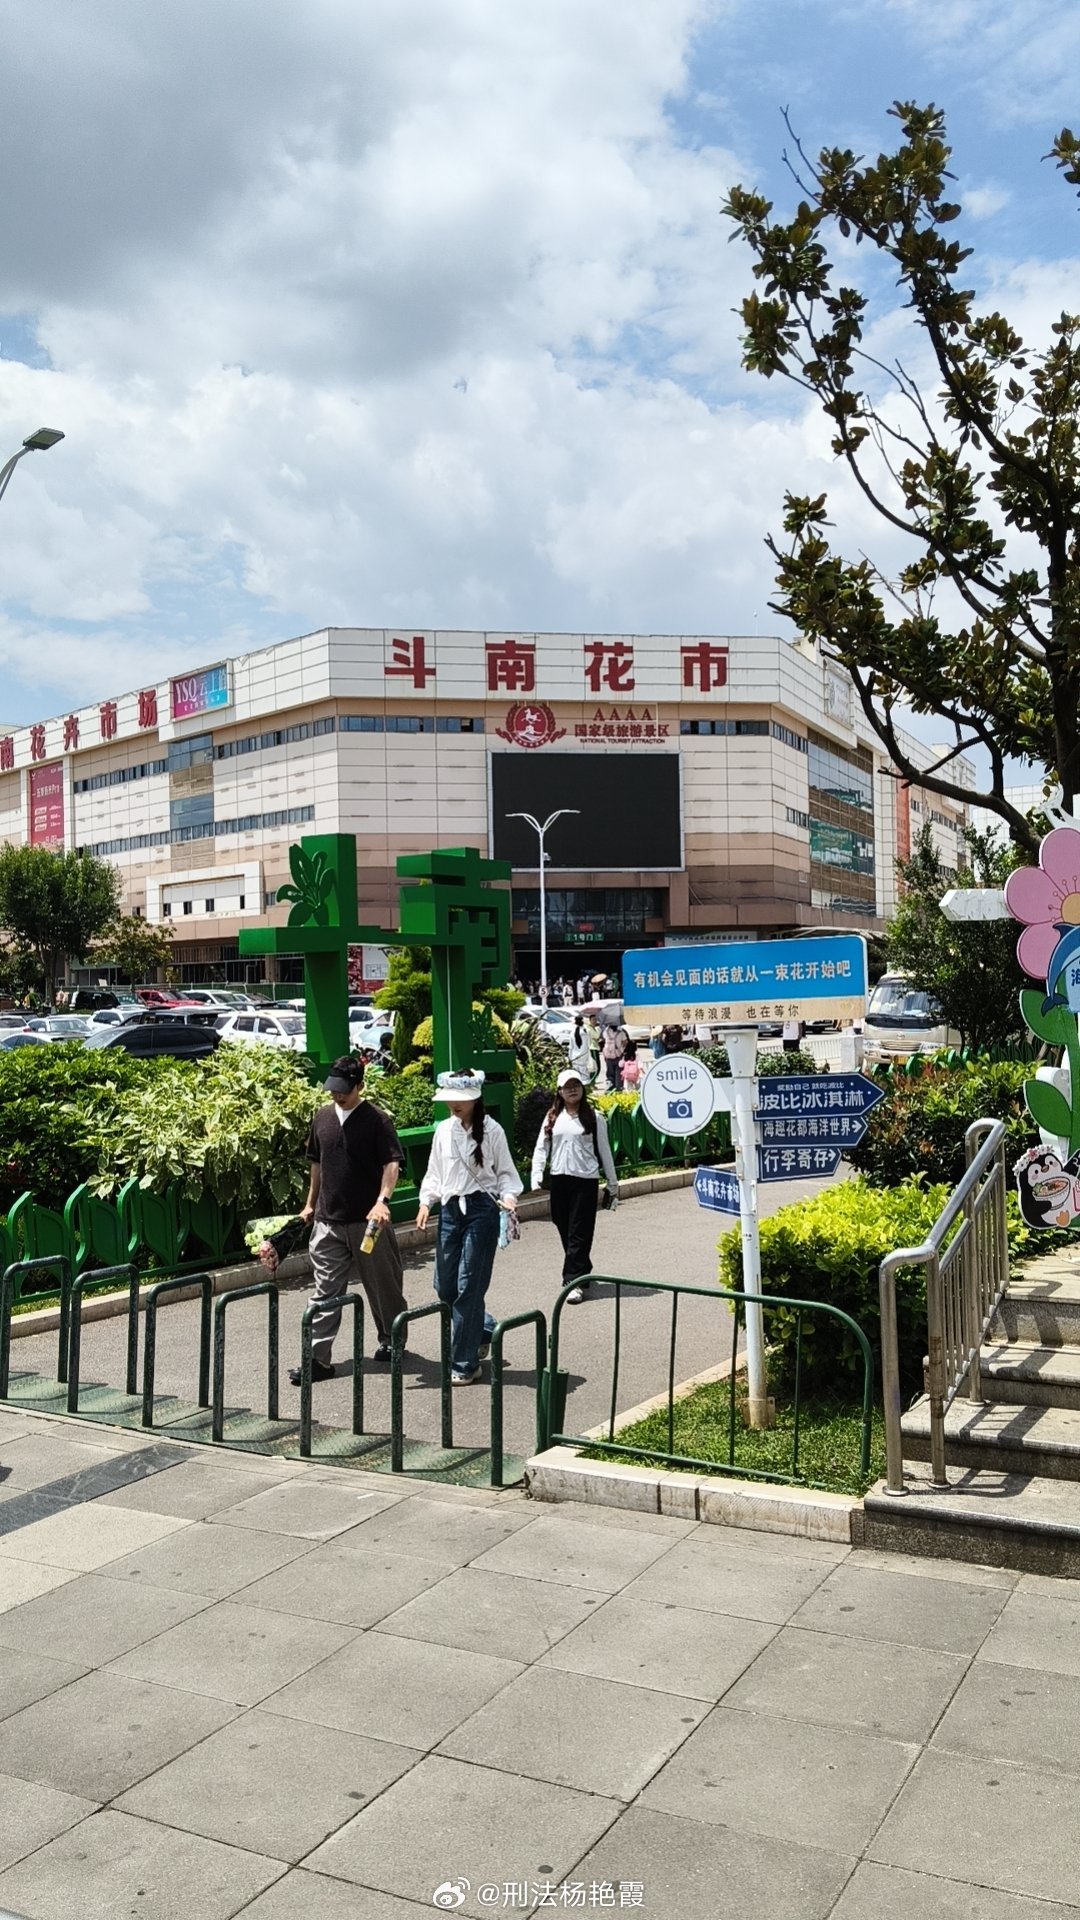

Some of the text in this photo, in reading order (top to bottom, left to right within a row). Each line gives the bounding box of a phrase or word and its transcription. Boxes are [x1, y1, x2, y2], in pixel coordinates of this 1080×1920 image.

[384, 636, 729, 692] 斗南花市
[175, 677, 198, 704] YSQ
[574, 723, 670, 737] 国家级旅游景区
[633, 960, 852, 989] 有机会见面的话就从一束花开始吧
[682, 1004, 800, 1021] 等待浪漫 也在等你
[656, 1066, 698, 1082] smile
[759, 1090, 865, 1111] 波比冰淇淋
[764, 1148, 829, 1173] 行李寄存
